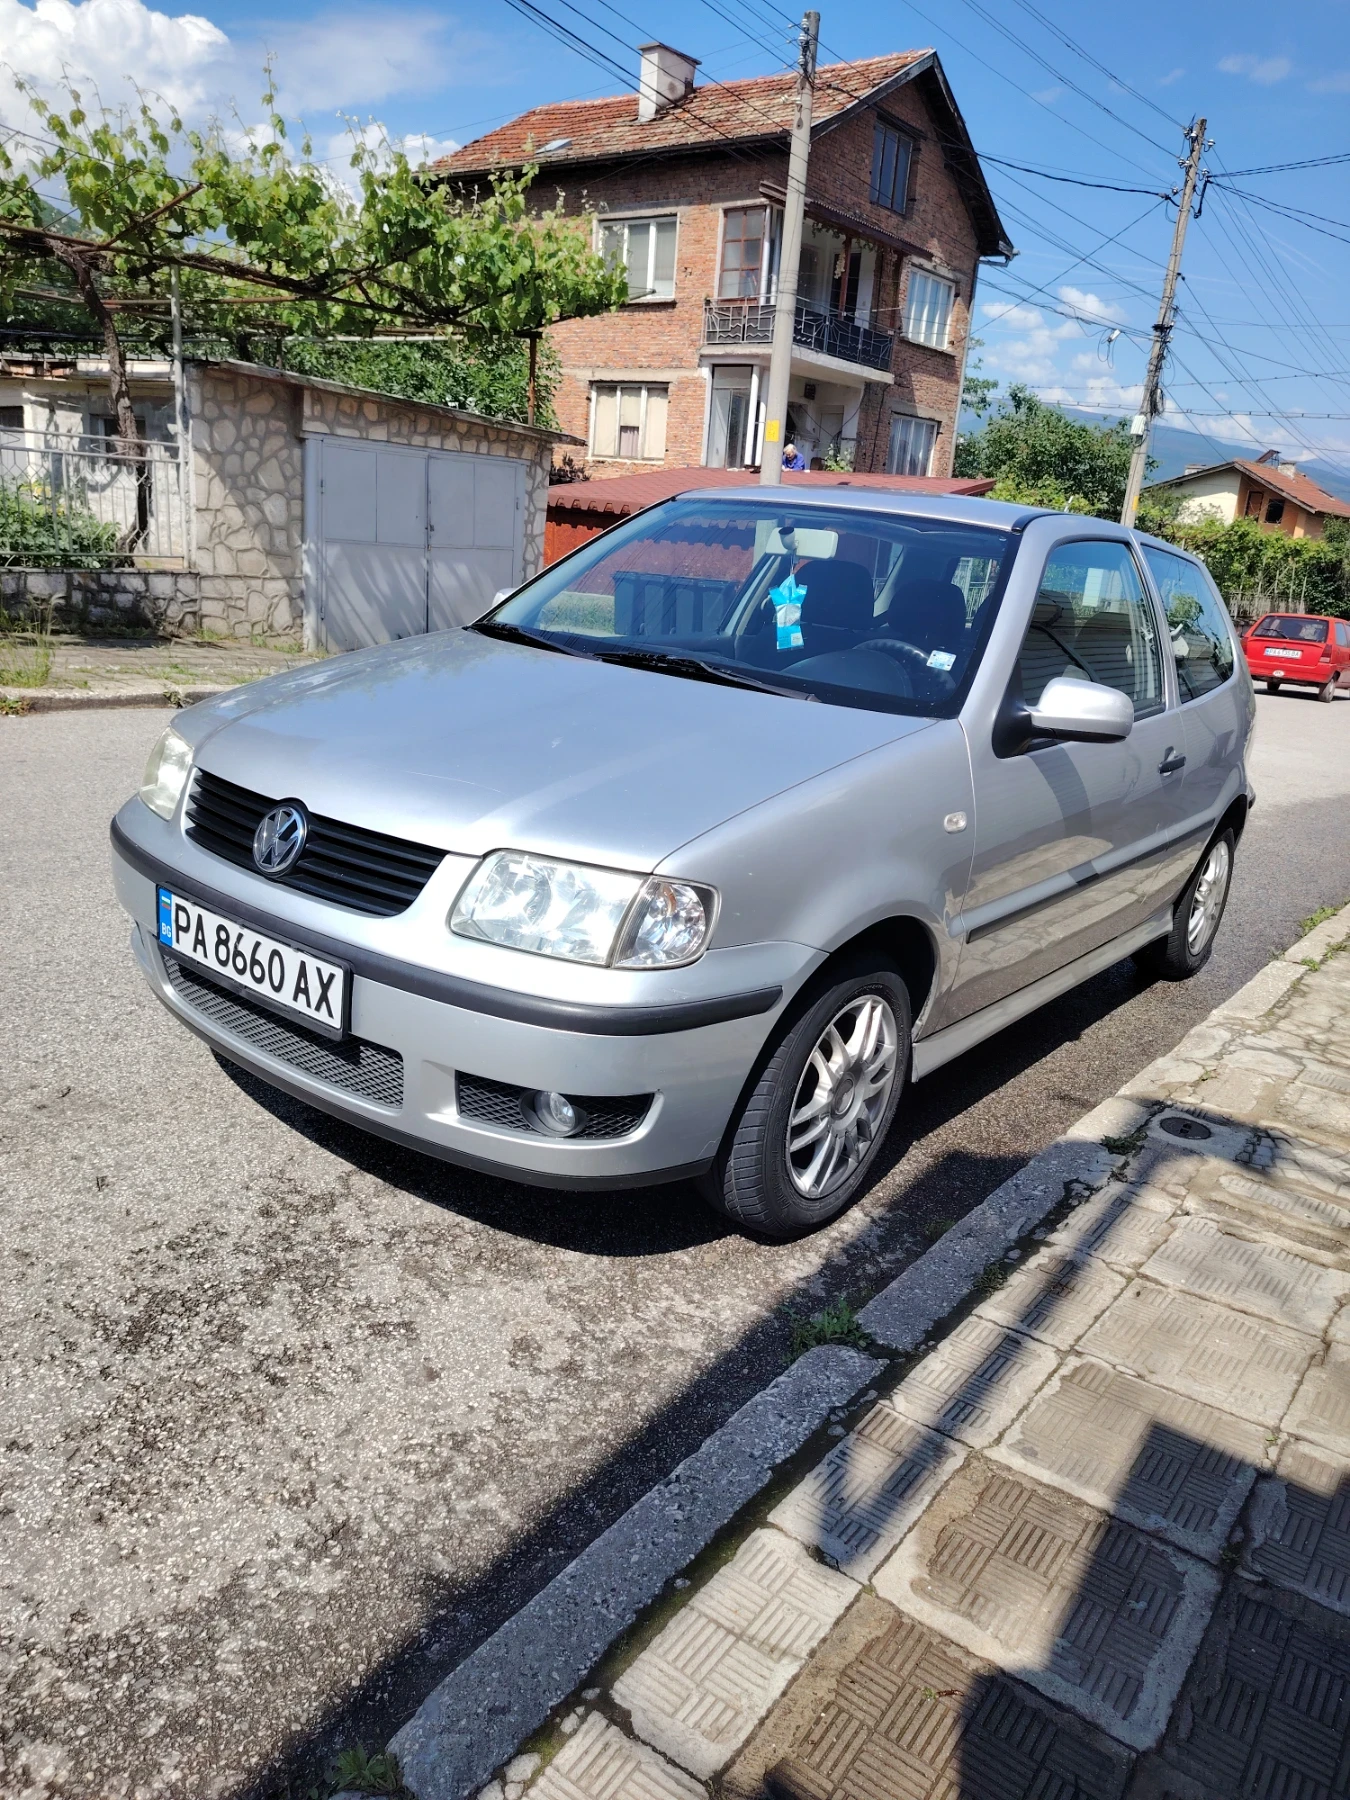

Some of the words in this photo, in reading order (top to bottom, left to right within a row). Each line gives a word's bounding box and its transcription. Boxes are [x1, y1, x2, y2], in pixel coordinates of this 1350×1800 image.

[161, 922, 172, 938] BG
[175, 903, 208, 959] PA
[215, 924, 285, 993] 8660
[292, 960, 336, 1019] AX
